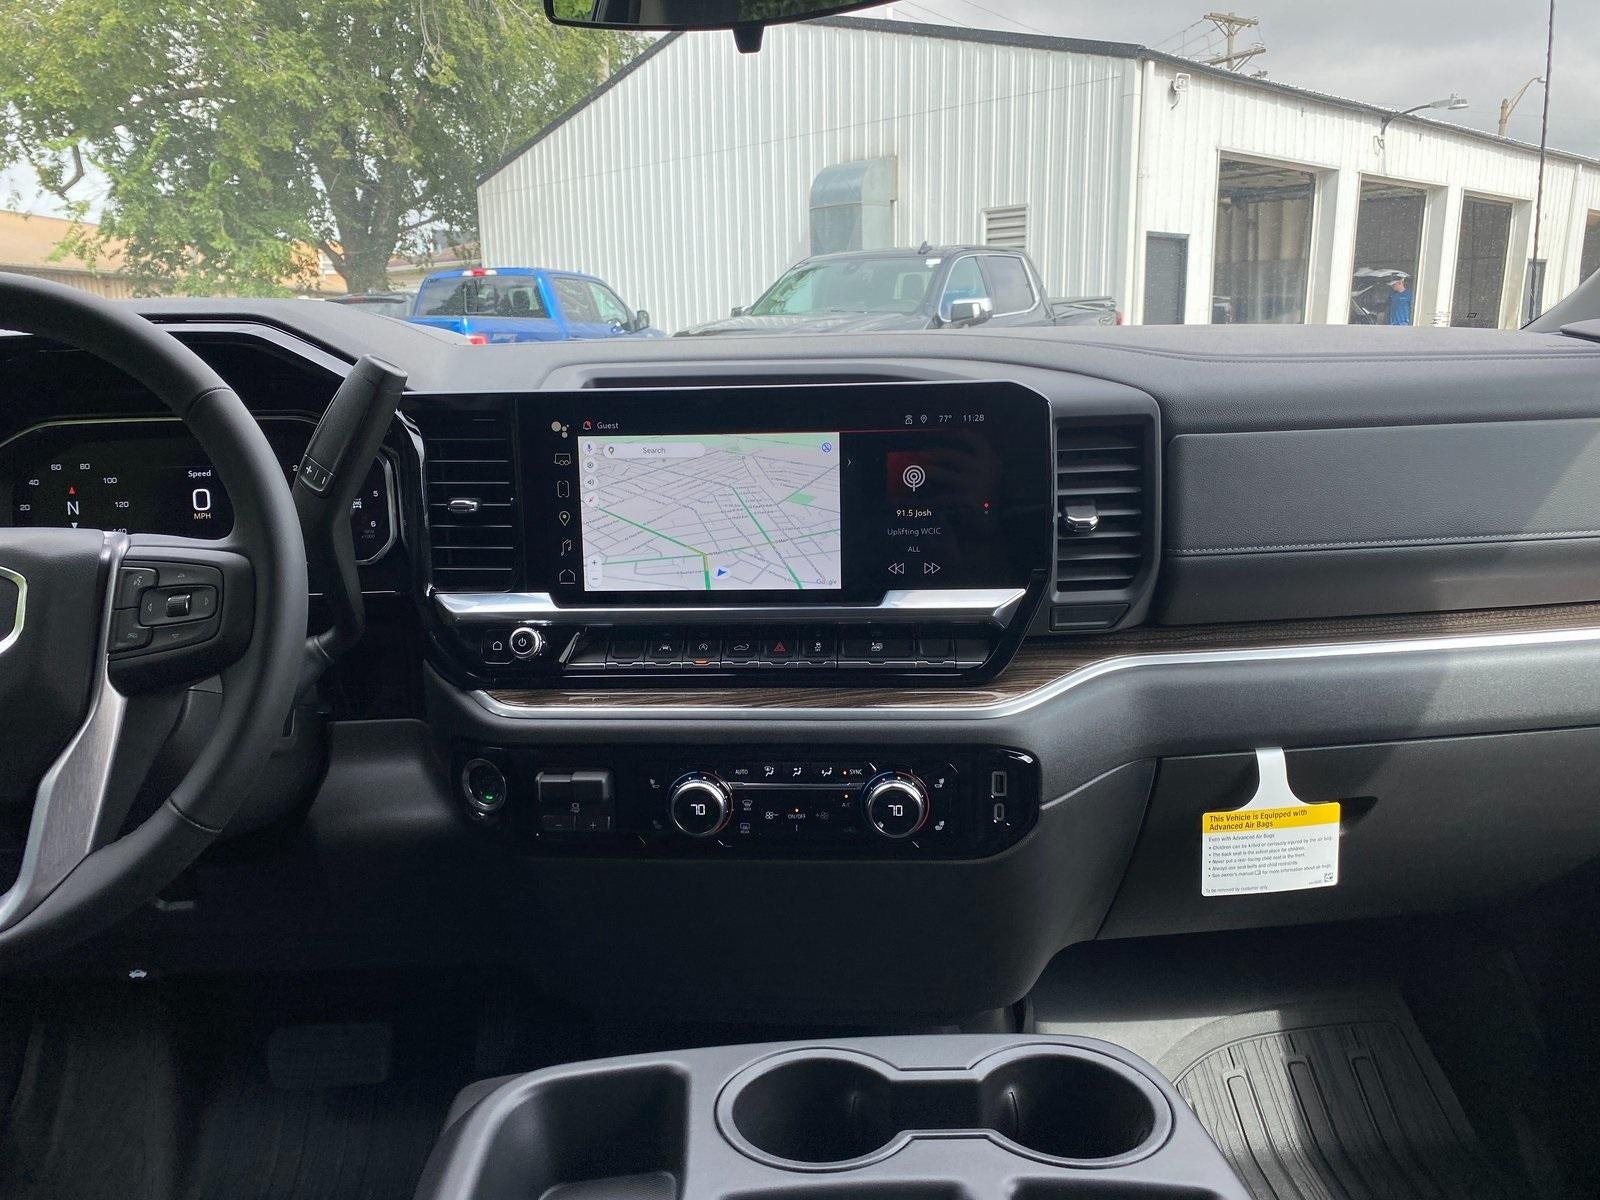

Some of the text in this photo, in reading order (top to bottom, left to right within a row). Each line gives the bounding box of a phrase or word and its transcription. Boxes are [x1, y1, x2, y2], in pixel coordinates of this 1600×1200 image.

[962, 414, 985, 423] 11:28
[596, 421, 619, 430] Guest
[642, 447, 666, 455] Search
[50, 463, 62, 471] 60
[79, 463, 91, 471] 80
[187, 470, 212, 478] Speed
[28, 479, 40, 487] 40
[102, 476, 118, 485] 100
[192, 488, 211, 511] 0
[19, 504, 31, 512] 20
[66, 500, 80, 516] N
[114, 501, 130, 509] 120
[193, 512, 212, 520] MPH
[896, 509, 932, 518] 91.5 Josh
[887, 527, 942, 537] Uplifting WCIC
[849, 768, 863, 776] SYNC
[690, 803, 706, 816] 70
[887, 804, 904, 817] 70
[1260, 811, 1291, 820] Equipped
[1209, 822, 1242, 831] Advanced
[1257, 821, 1273, 829] Bags
